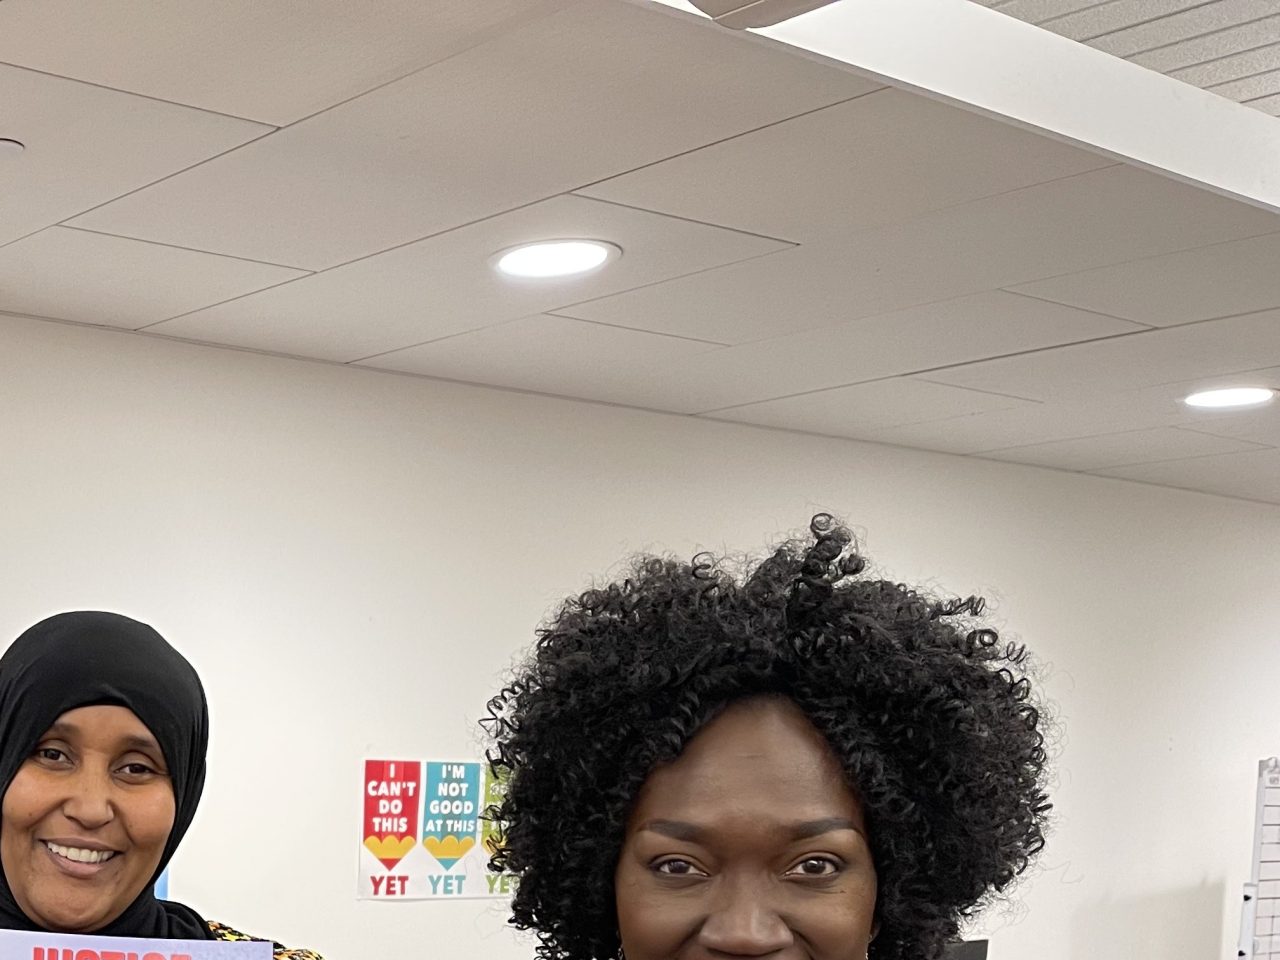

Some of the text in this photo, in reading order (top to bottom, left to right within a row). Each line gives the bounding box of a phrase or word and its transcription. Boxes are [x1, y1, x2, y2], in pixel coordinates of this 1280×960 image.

[389, 763, 395, 778] I
[442, 765, 465, 779] I'M
[367, 781, 416, 797] CAN'T
[438, 783, 468, 797] NOT
[379, 800, 402, 814] DO
[429, 800, 473, 814] GOOD
[372, 817, 407, 832] THIS
[425, 820, 475, 832] AT THIS
[370, 875, 409, 895] YET
[428, 875, 466, 895] YET
[485, 875, 510, 894] YE
